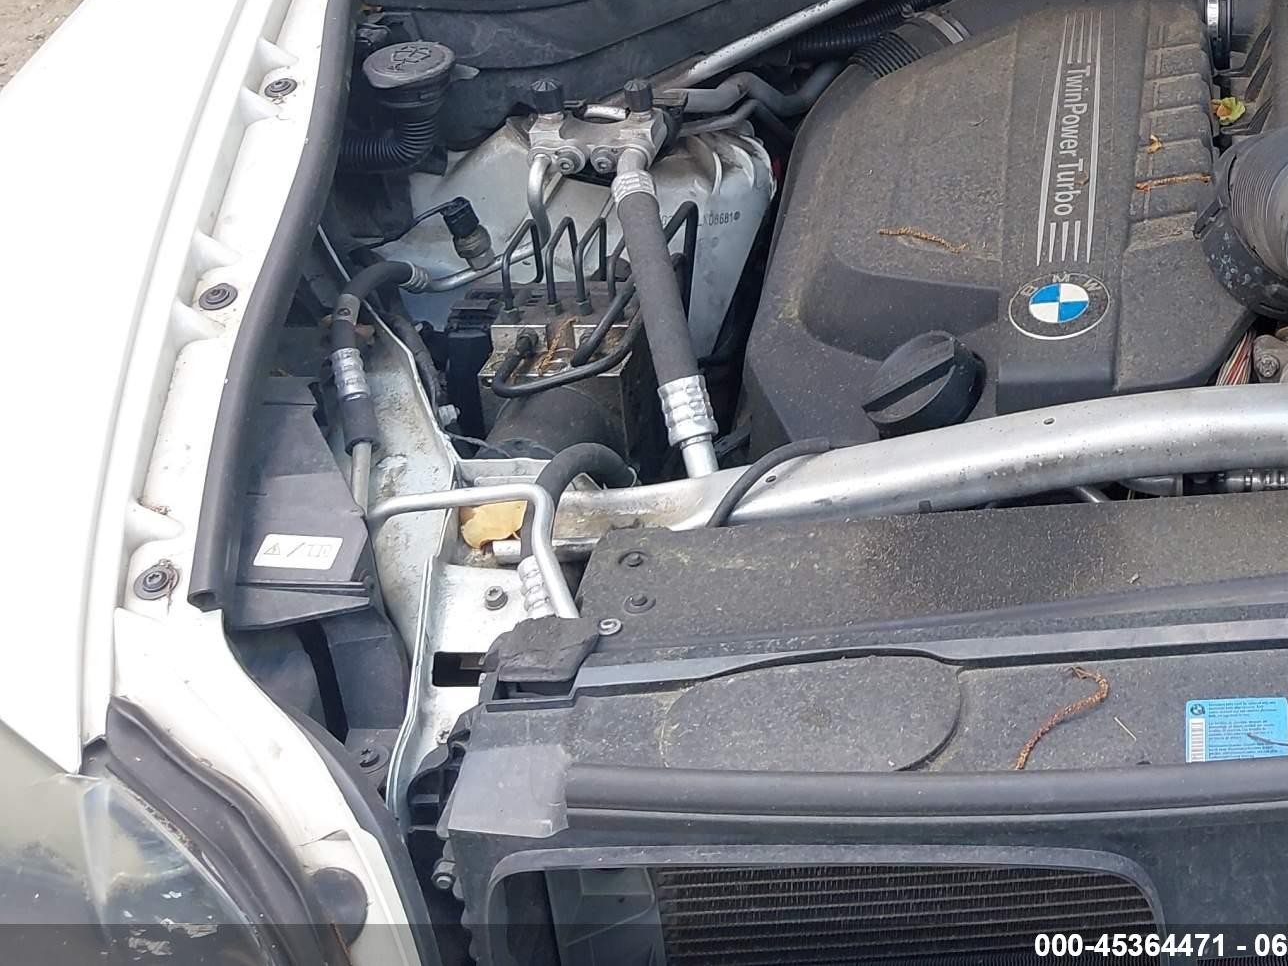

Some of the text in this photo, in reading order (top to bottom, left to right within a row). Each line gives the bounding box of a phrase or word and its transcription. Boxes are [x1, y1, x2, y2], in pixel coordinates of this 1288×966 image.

[1054, 65, 1090, 216] TwinPower Turbo
[1020, 272, 1103, 296] BMW
